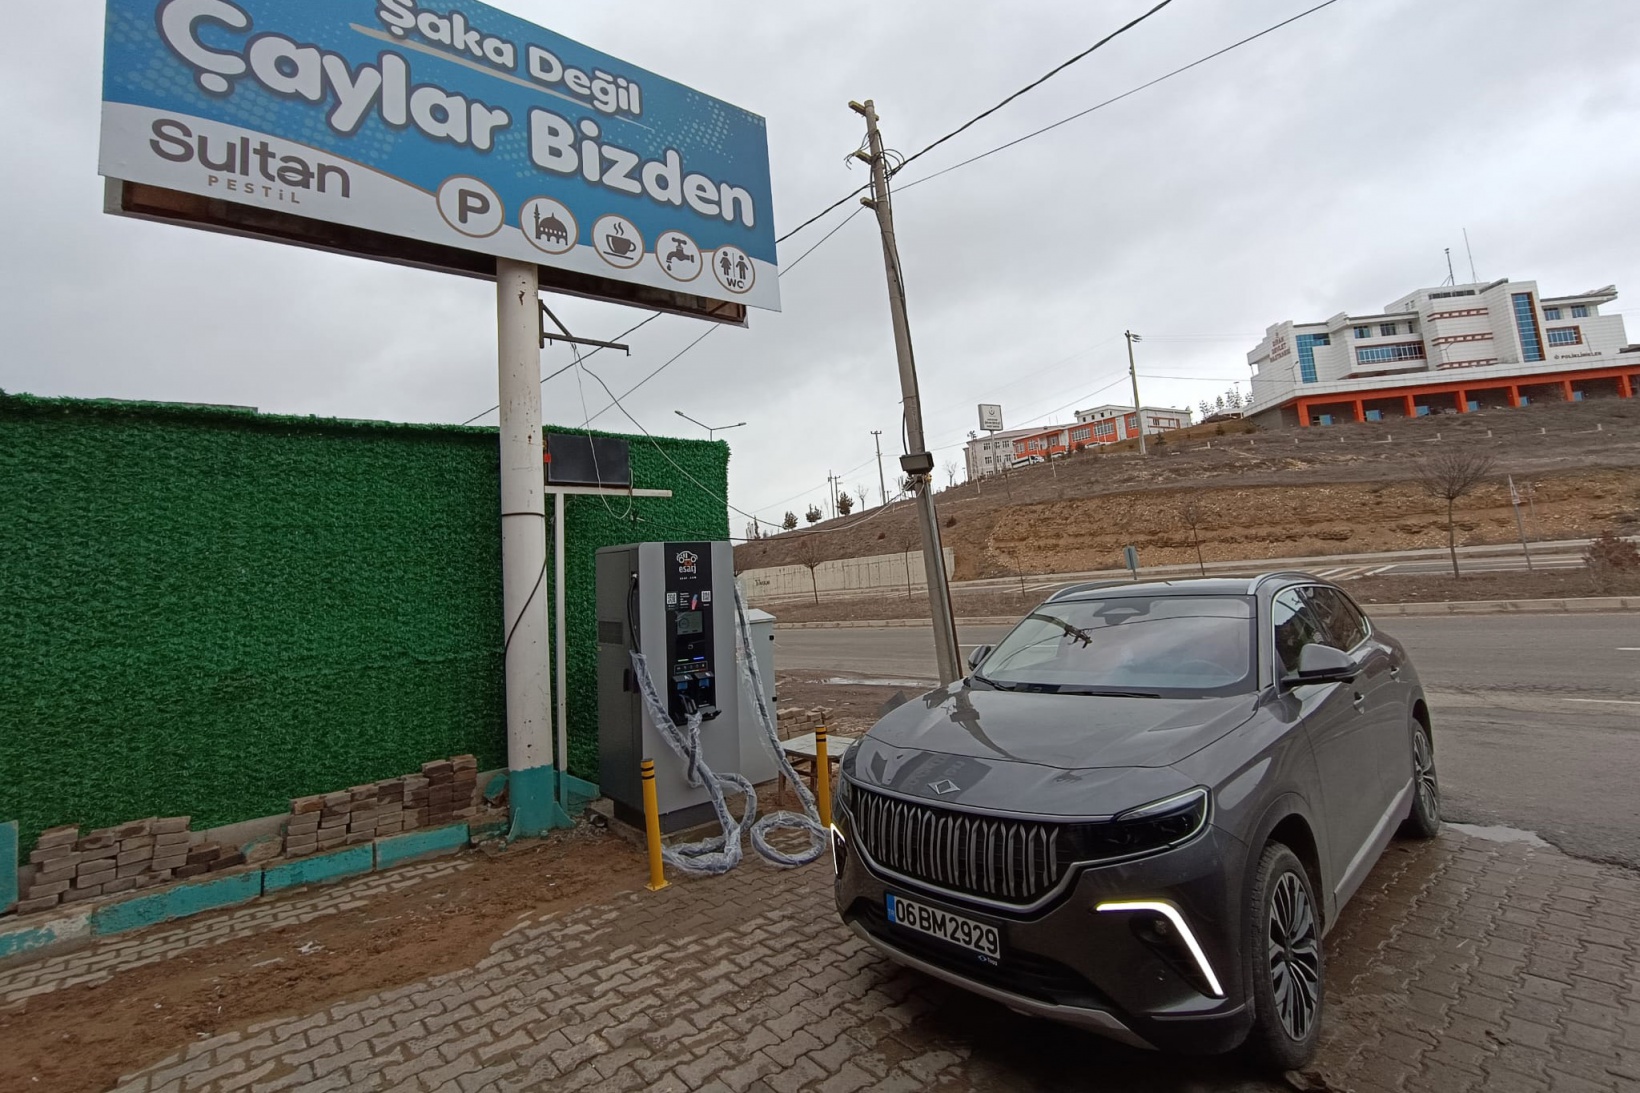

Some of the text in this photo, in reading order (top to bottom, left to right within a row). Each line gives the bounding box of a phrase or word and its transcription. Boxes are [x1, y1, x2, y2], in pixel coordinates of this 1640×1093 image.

[379, 0, 641, 115] Şaka Değil
[160, 0, 755, 228] Çaylar Bizden
[149, 118, 351, 199] Sultan
[458, 188, 490, 224] P
[726, 276, 745, 289] WC
[896, 899, 917, 926] 06
[918, 906, 947, 938] BM
[949, 917, 998, 955] 2929
